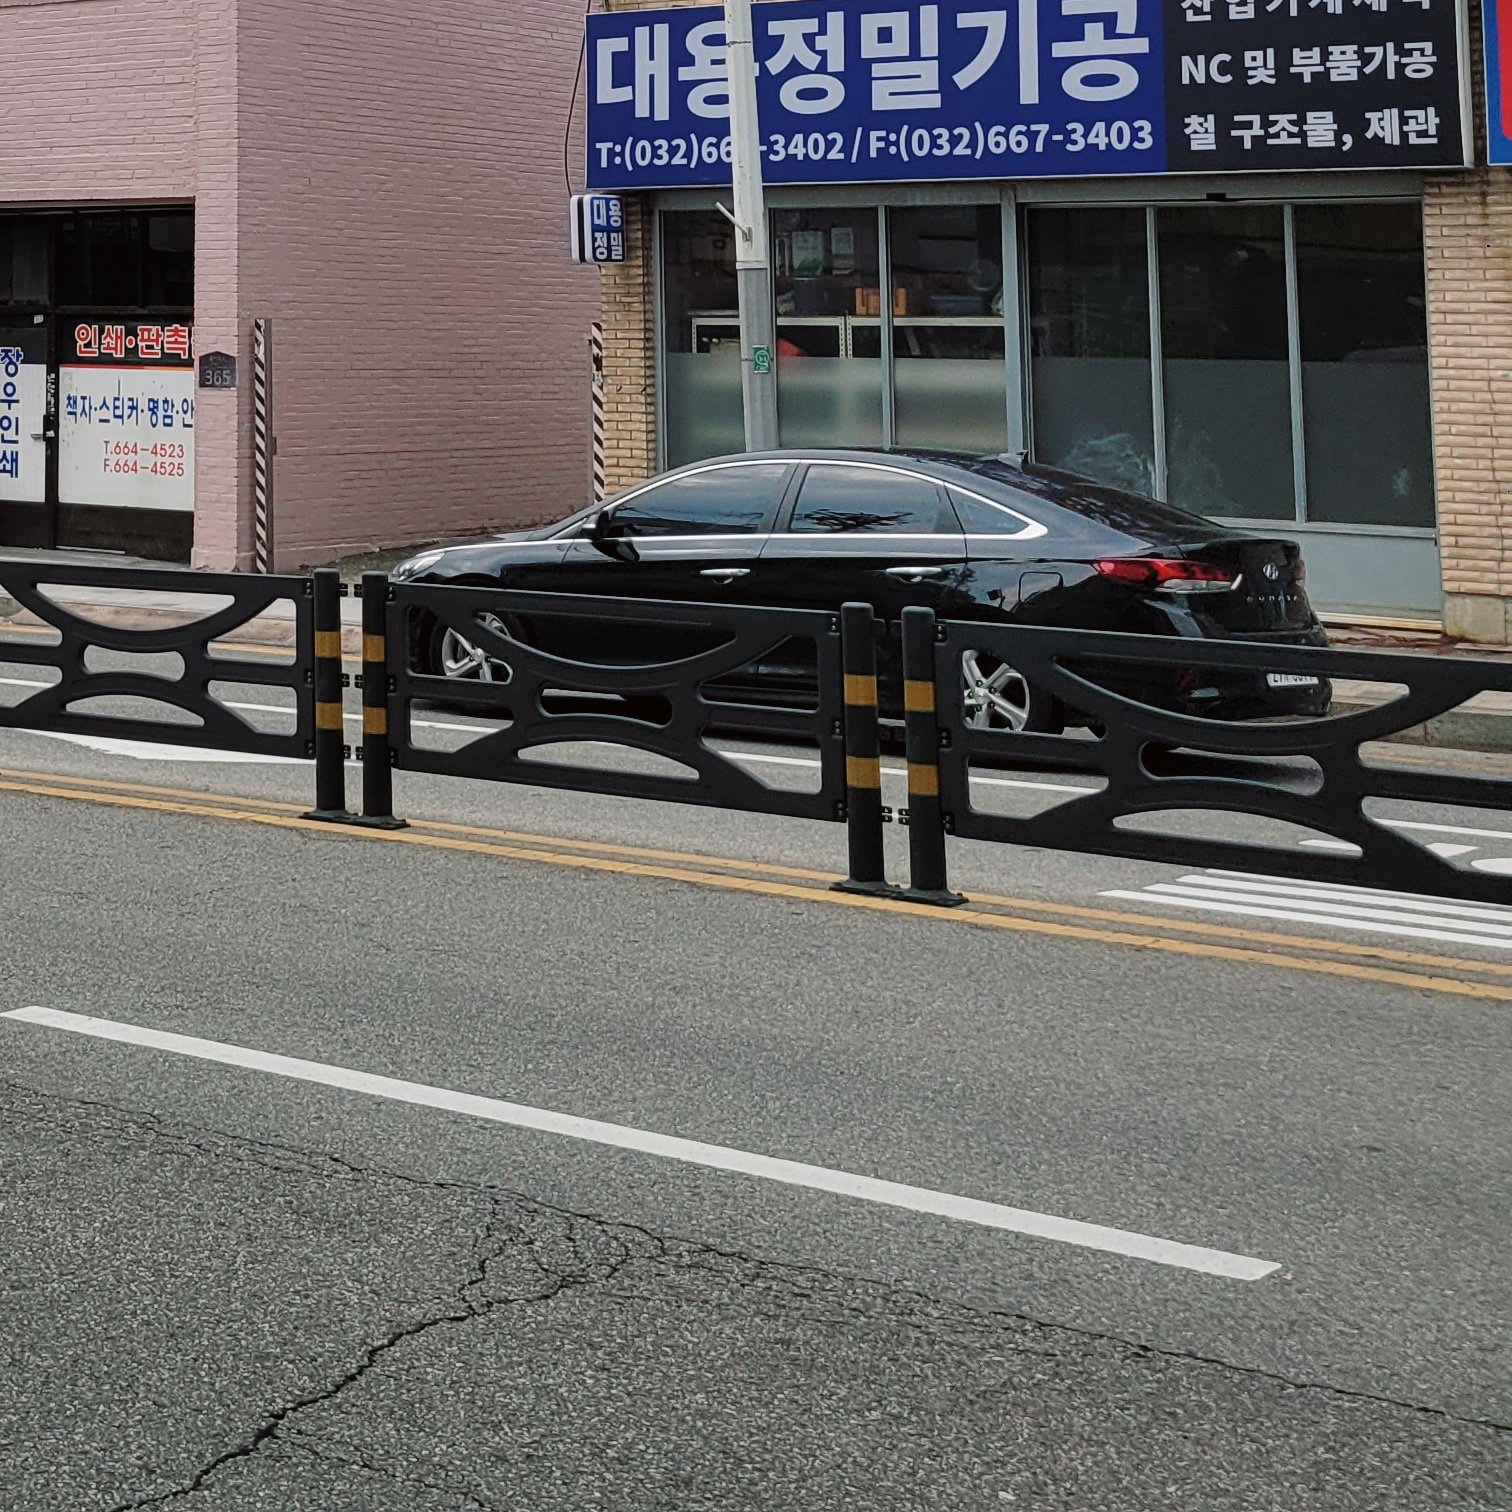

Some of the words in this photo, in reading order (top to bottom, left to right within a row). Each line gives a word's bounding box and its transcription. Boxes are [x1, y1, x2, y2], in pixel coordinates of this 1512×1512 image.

[1180, 53, 1232, 85] NC
[1244, 47, 1276, 86] 및
[1289, 41, 1438, 83] 부품가공
[1183, 113, 1218, 151] 철
[1230, 110, 1354, 152] 구조물,
[1364, 106, 1440, 147] 제관
[595, 131, 845, 172] T:(032)66-3402
[869, 119, 1153, 164] F:(032)667-3403
[593, 199, 622, 227] 대용
[594, 231, 623, 260] 정밀
[75, 324, 194, 359] 인쇄·판촉
[204, 370, 231, 385] 365
[103, 440, 185, 459] T.664-4523
[103, 458, 185, 477] F.664-4525
